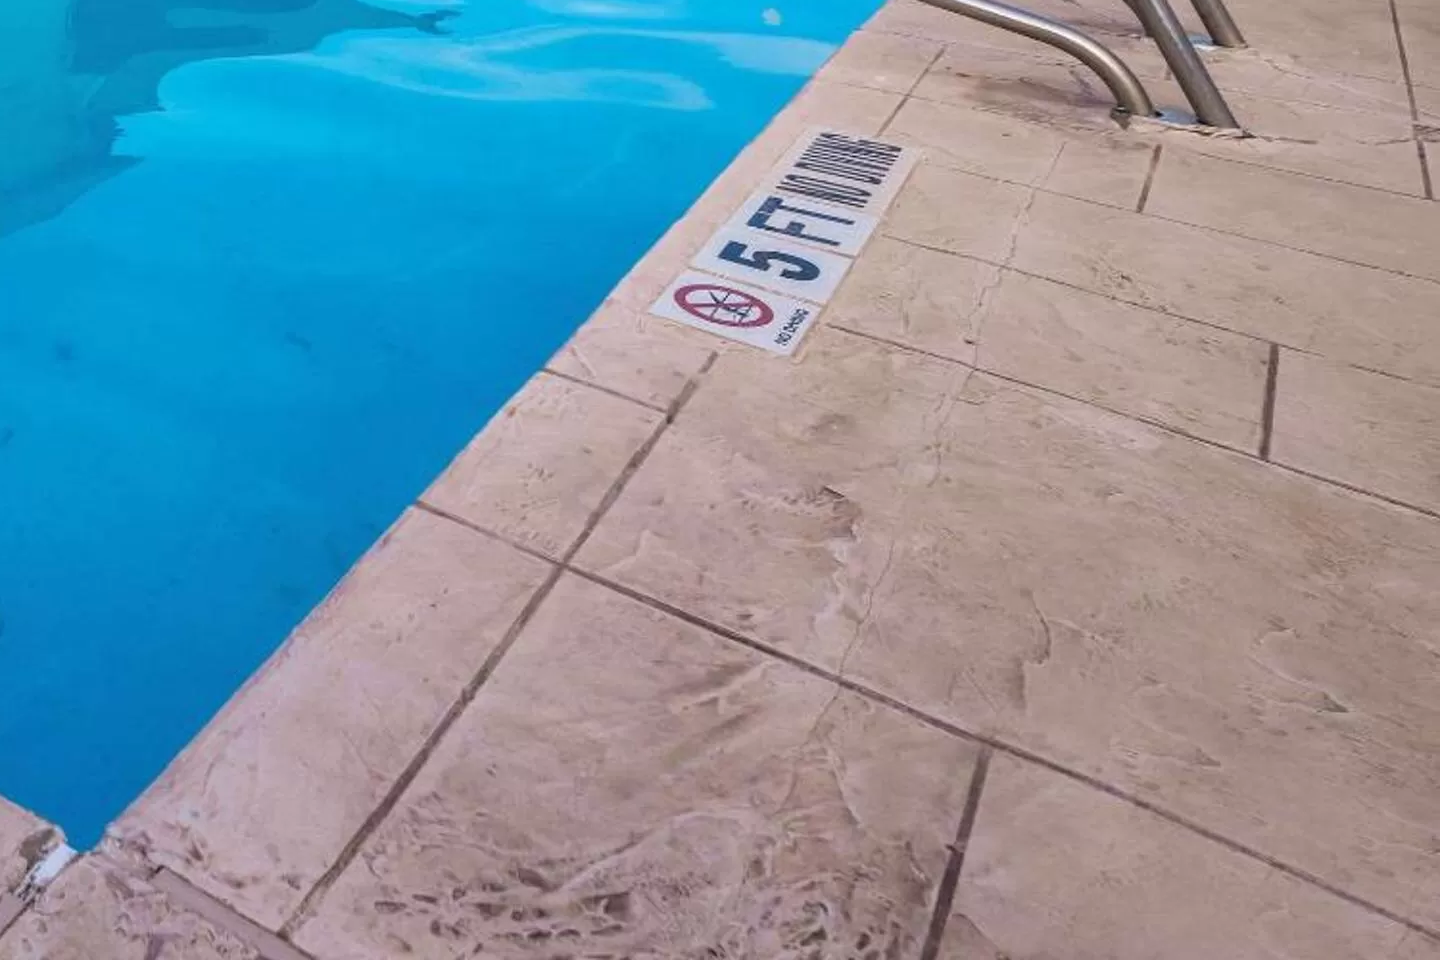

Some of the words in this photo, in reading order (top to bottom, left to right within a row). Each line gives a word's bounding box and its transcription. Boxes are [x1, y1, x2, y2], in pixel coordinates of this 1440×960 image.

[793, 132, 902, 185] DIVING
[775, 173, 873, 208] NO
[746, 195, 855, 246] FT
[717, 240, 821, 282] 5
